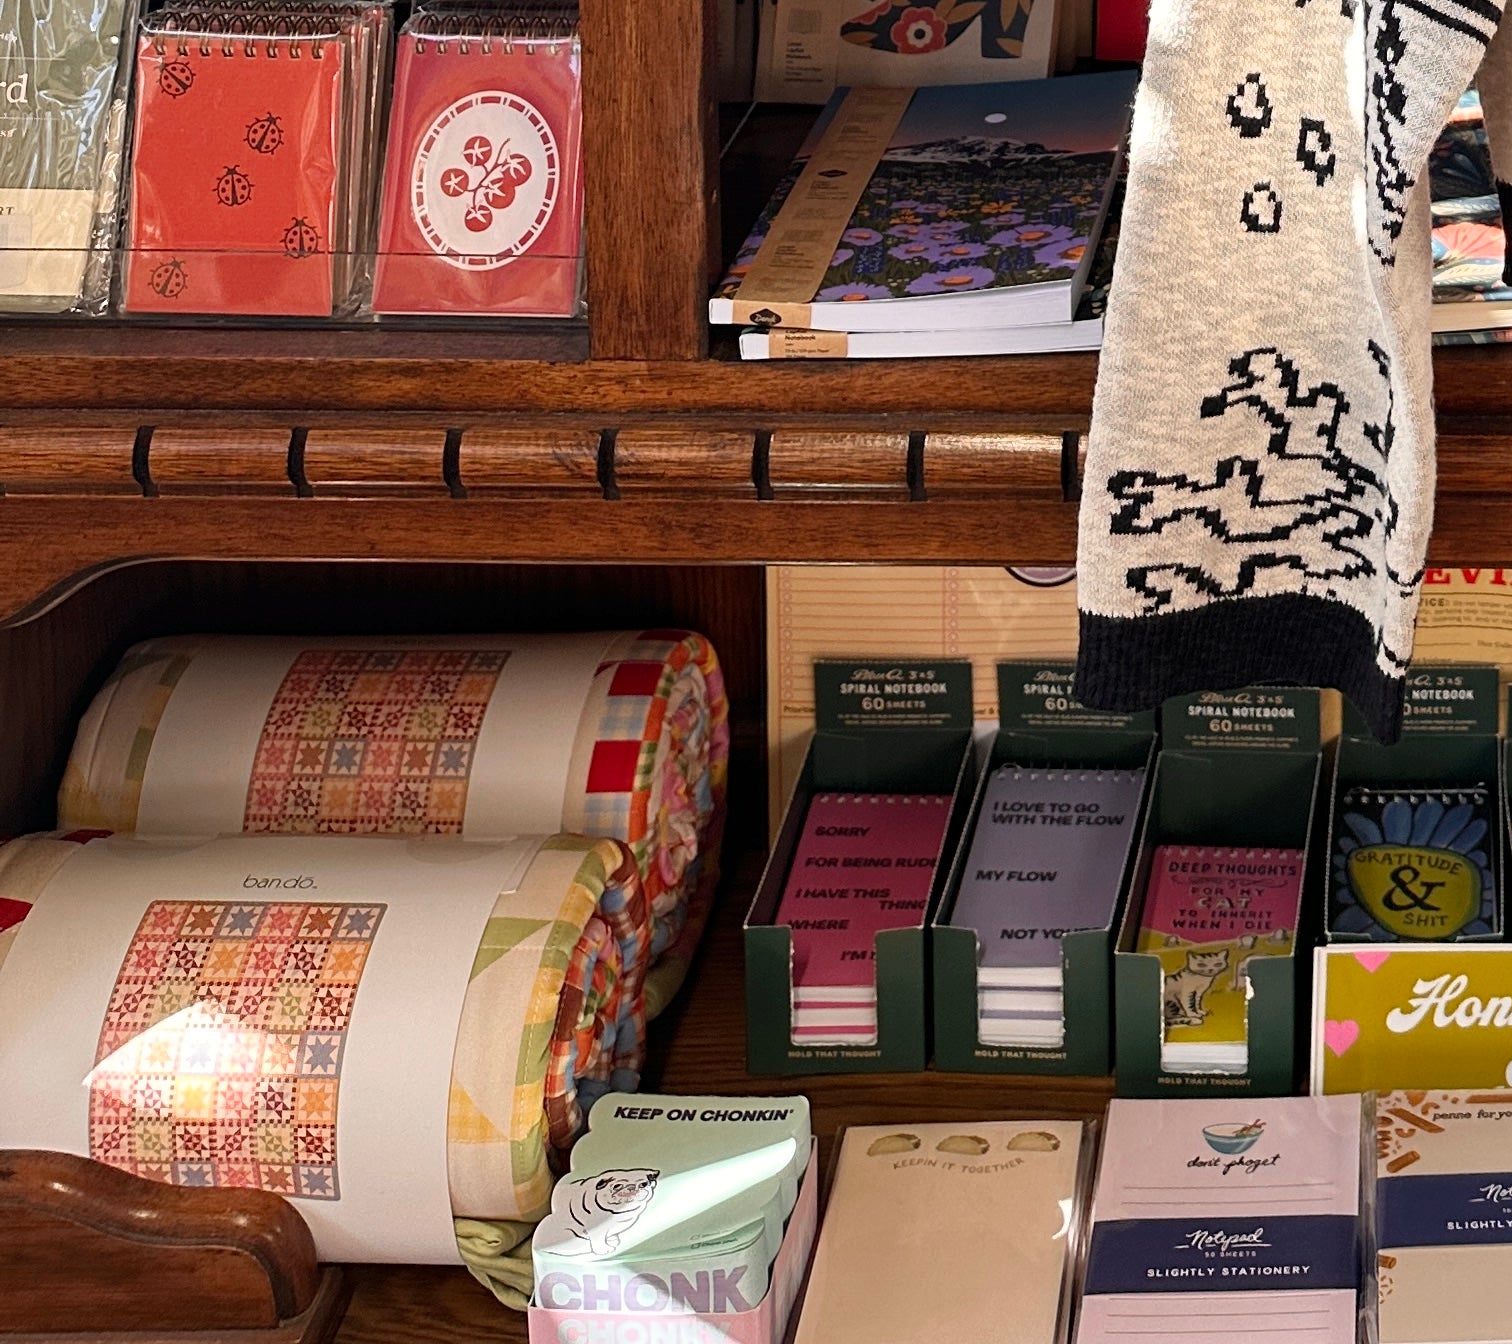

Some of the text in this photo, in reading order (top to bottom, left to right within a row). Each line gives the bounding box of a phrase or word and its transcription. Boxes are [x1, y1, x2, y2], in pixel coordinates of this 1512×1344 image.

[840, 683, 947, 694] SPIRAL NOTEBOOK
[1024, 684, 1063, 694] SPIRAL
[1412, 689, 1475, 700] NOTEBOOK
[862, 697, 885, 710] 60
[1045, 698, 1067, 710] 60
[1188, 705, 1296, 718] SPIRAL NOTEBOOK
[1209, 719, 1232, 732] 60
[1001, 802, 1046, 812] LOVE
[1050, 803, 1072, 812] TO
[1074, 803, 1100, 813] GO
[991, 814, 1125, 826] WITH THE FLOW
[815, 826, 871, 836] SORRY
[805, 857, 894, 868] FOR BEING
[1168, 861, 1297, 876] DEEP THOUGHTS
[1355, 851, 1463, 875] GRATITUDE
[975, 870, 1058, 882] MY FLOW
[804, 889, 849, 898] HAVE
[853, 889, 891, 898] THIS
[1191, 887, 1265, 896] FOR MY
[1382, 865, 1446, 911] &
[1197, 897, 1253, 910] CAT
[1179, 909, 1273, 919] TO INHERIT
[1404, 913, 1448, 926] SHIT
[788, 919, 850, 930] WHERE
[1172, 920, 1221, 929] WHEN
[1245, 921, 1273, 930] DIE
[1000, 929, 1039, 939] NOT
[815, 1050, 838, 1058] THAT
[840, 1050, 882, 1058] THOUGHT
[1001, 1051, 1024, 1059] THAT
[1026, 1051, 1067, 1059] THOUGHT
[1185, 1077, 1208, 1085] THAT
[1210, 1078, 1251, 1086] THOUGHT
[614, 1106, 794, 1122] KEEP ON CHONKIN'
[1433, 1112, 1472, 1122] penne
[1477, 1109, 1495, 1119] for
[893, 1157, 1025, 1174] KEEPIN IT TOGETHER
[1186, 1228, 1264, 1251] Notepad
[1147, 1265, 1311, 1277] SLIGHTLY STATIONERY
[539, 1265, 749, 1313] CHONK
